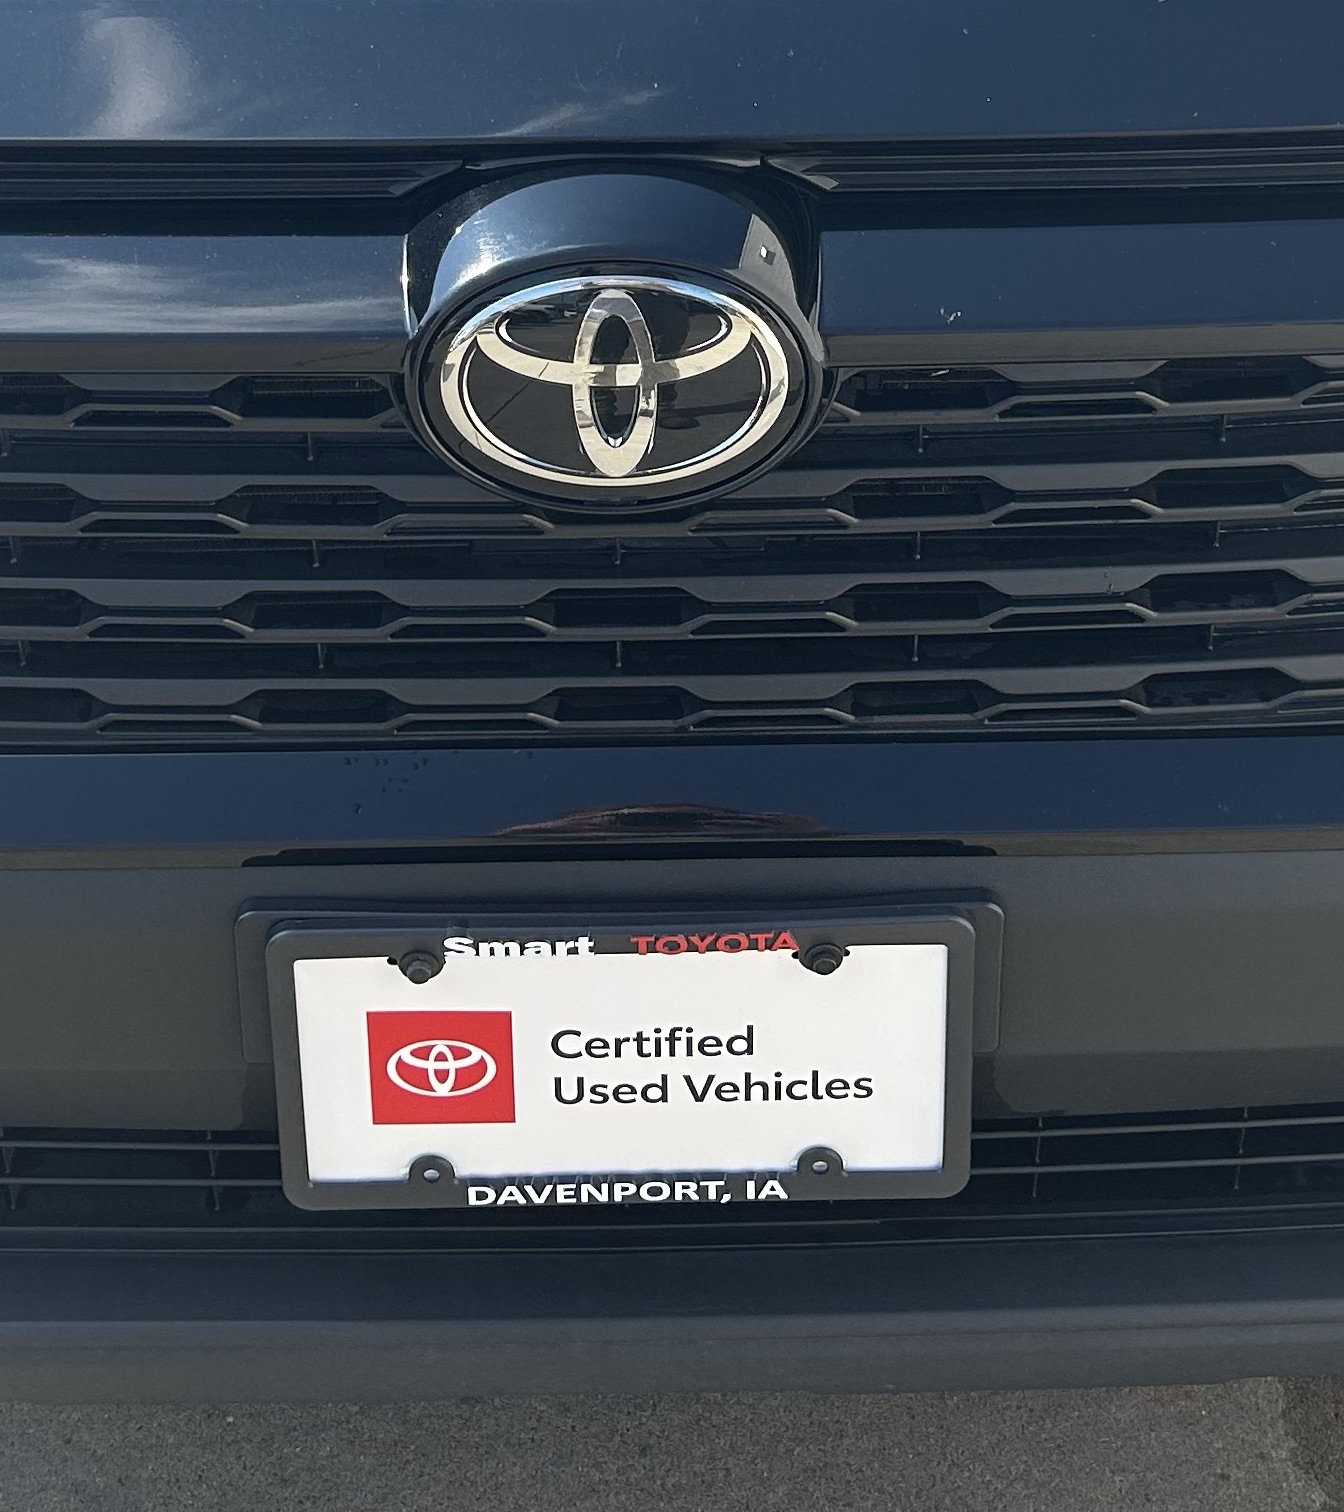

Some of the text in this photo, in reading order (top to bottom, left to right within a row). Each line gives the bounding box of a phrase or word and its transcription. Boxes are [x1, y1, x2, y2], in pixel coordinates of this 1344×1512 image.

[442, 930, 800, 958] Smart TOYOTA
[551, 1024, 754, 1059] Certified
[554, 1070, 874, 1104] Used Vehicles
[467, 1179, 789, 1206] DAVENPORT, IA
